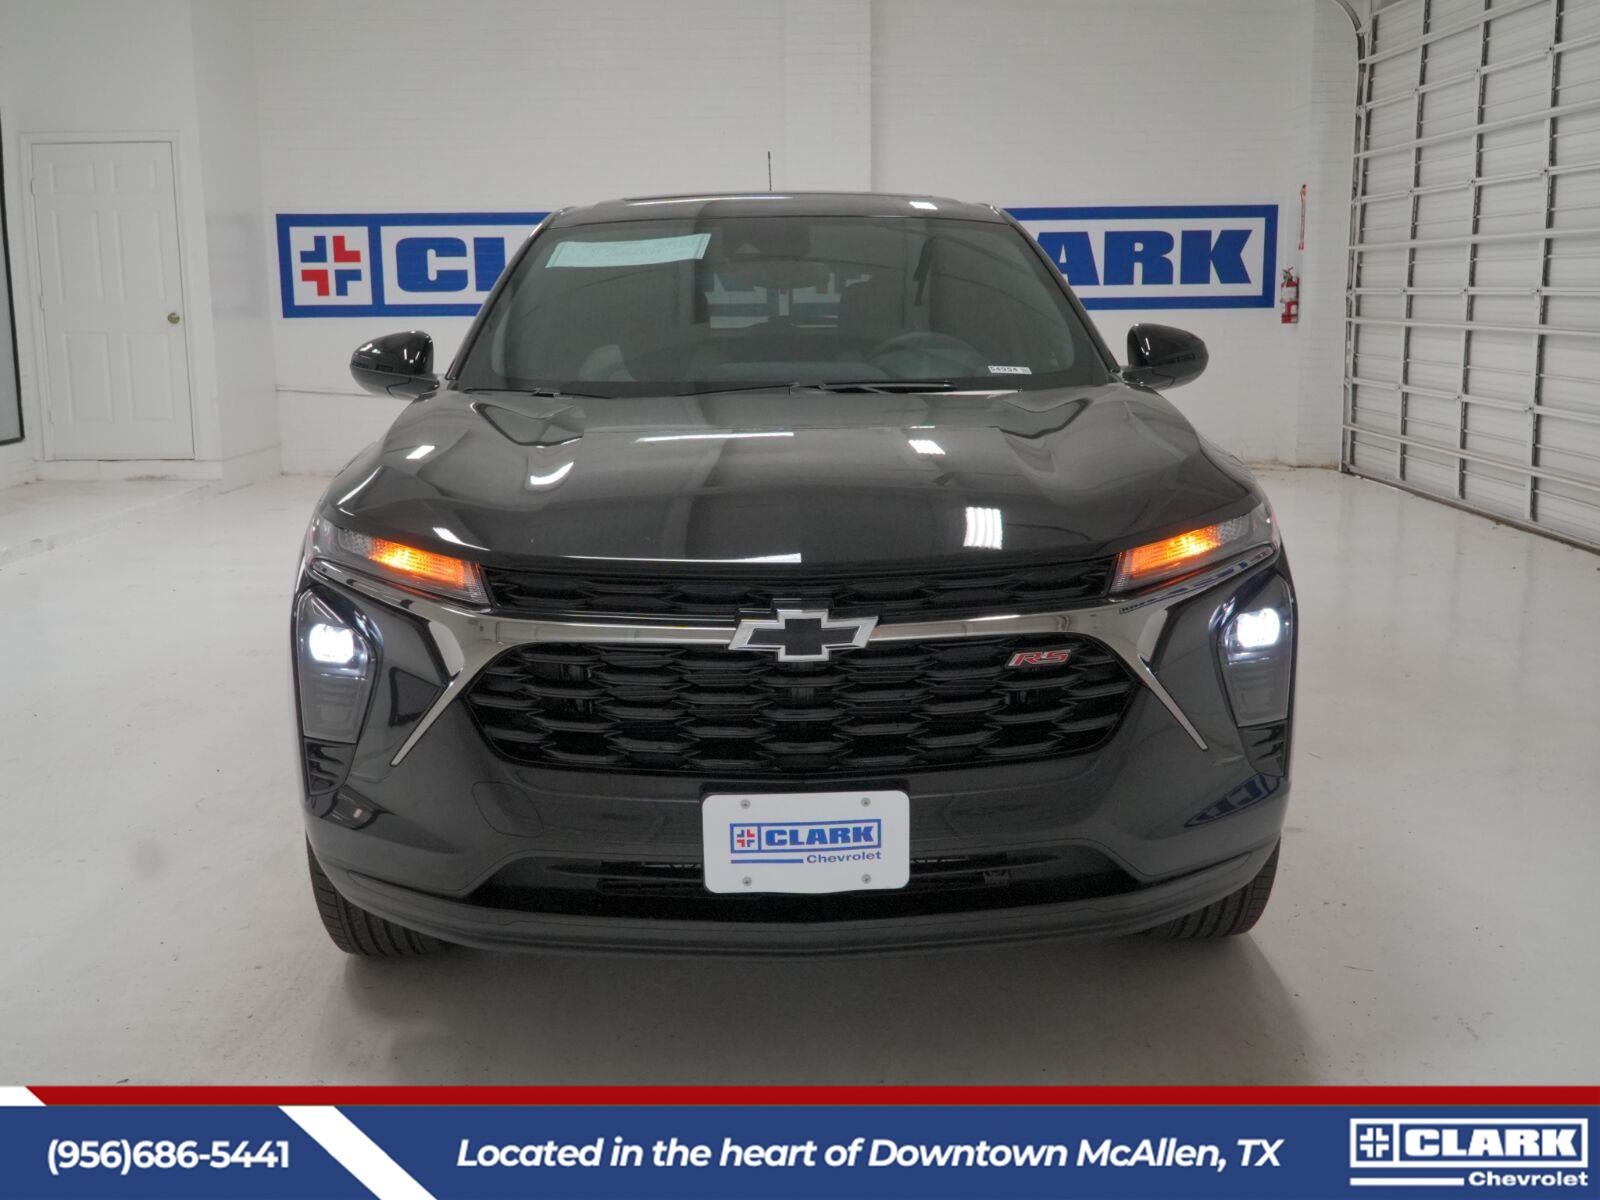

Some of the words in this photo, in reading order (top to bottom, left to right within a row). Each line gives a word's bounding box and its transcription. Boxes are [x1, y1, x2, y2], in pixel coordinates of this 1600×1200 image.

[1008, 650, 1071, 667] RS
[765, 826, 874, 846] CLARK
[806, 850, 881, 864] Chevrolet
